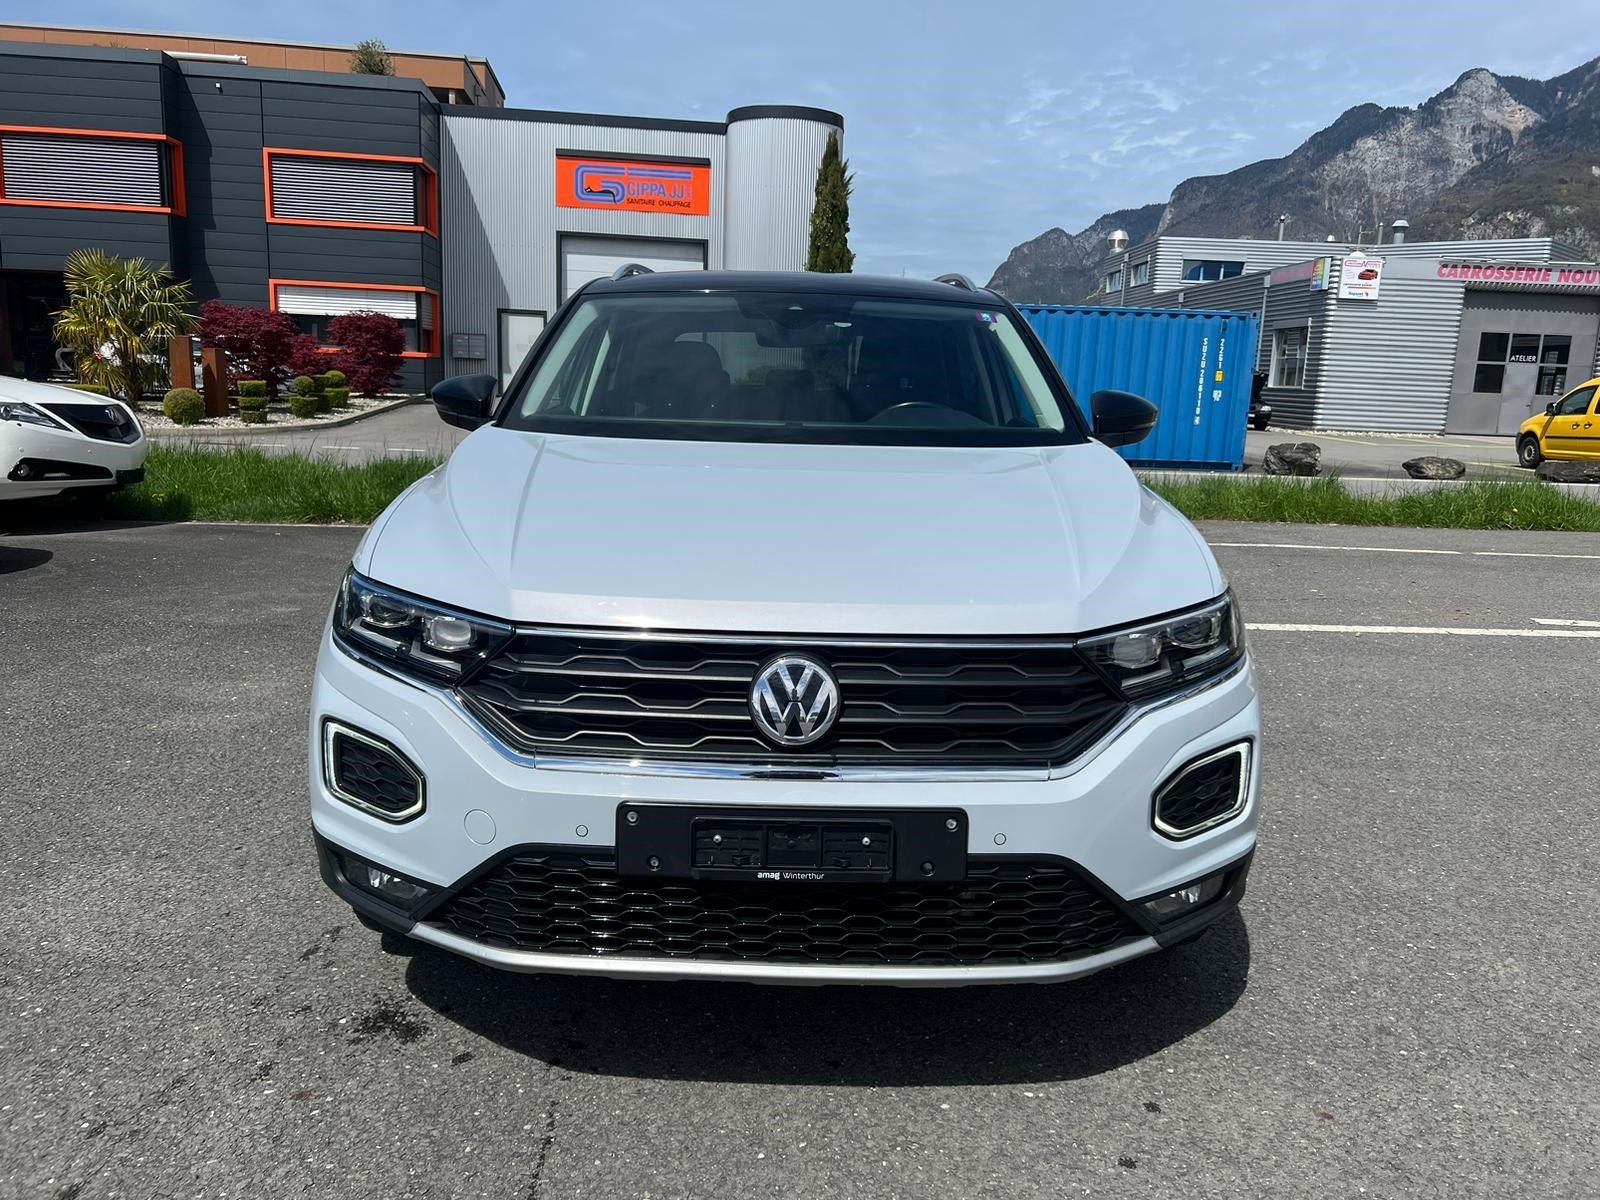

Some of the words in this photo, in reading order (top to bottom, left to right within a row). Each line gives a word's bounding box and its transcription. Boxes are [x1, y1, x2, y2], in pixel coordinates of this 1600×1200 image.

[627, 181, 666, 197] GIPPA
[626, 197, 656, 207] SANITAIRE
[658, 199, 692, 209] CHAUFFAGE
[1437, 263, 1553, 283] CARROSSERIE
[1557, 268, 1600, 285] NOU
[1510, 354, 1537, 362] ATELIER
[757, 871, 781, 880] amag
[782, 872, 825, 880] Winterthur
